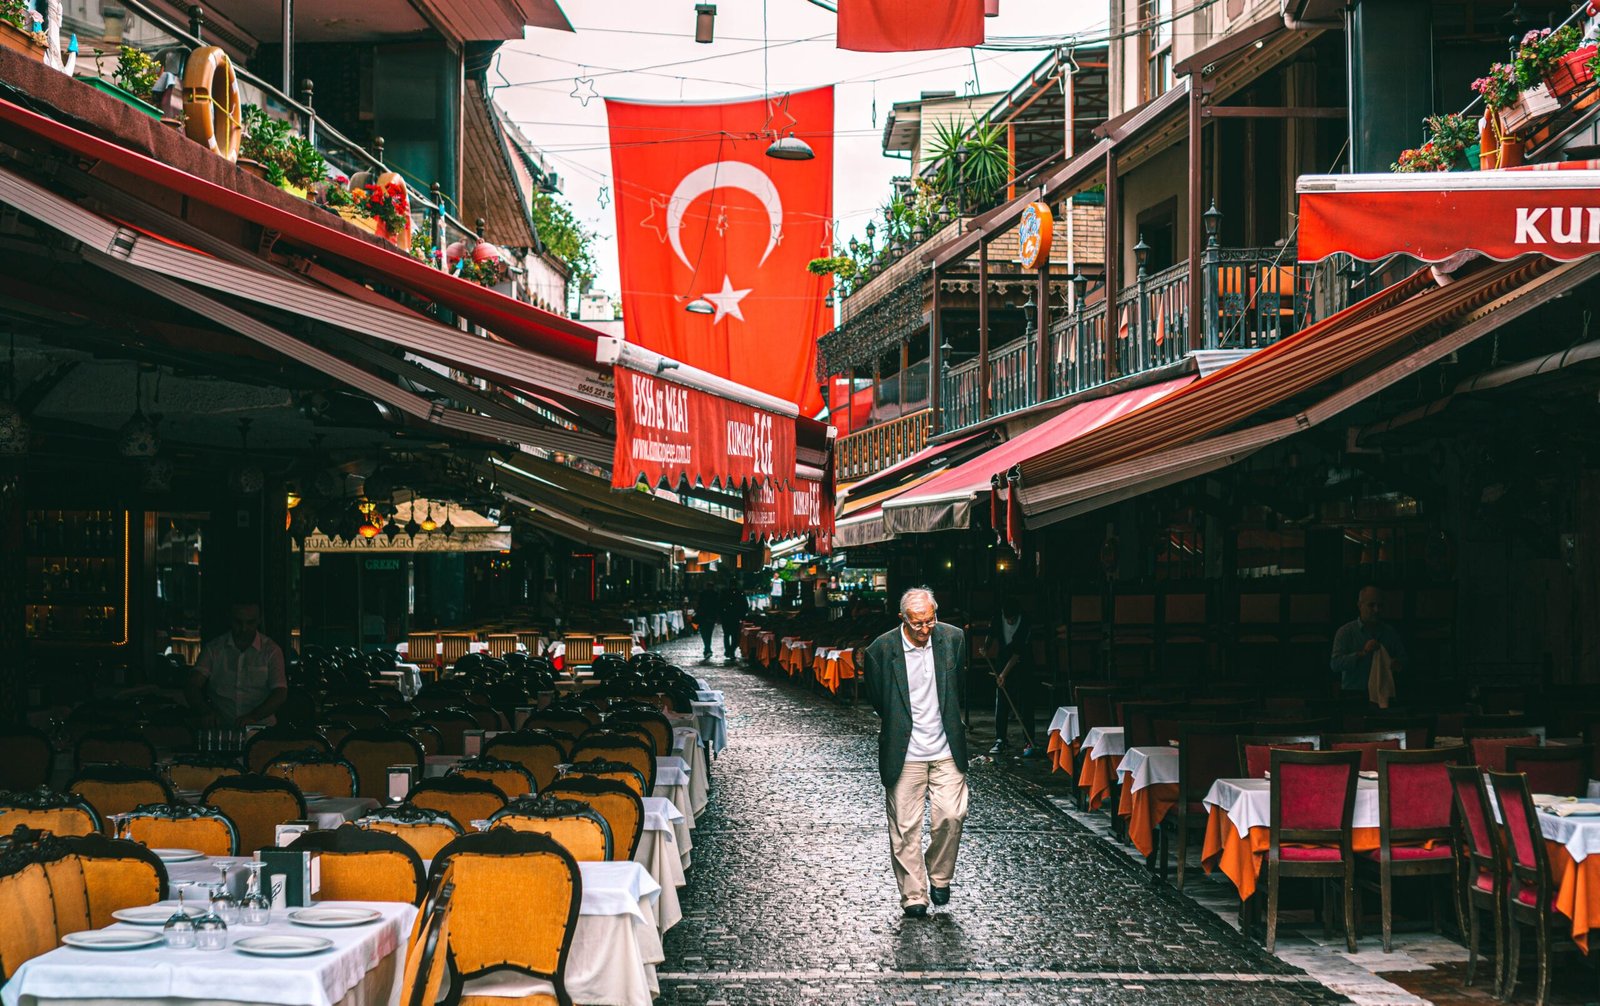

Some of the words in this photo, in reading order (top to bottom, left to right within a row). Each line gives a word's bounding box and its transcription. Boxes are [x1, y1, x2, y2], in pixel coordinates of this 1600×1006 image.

[578, 383, 593, 393] 0545
[594, 388, 606, 396] 221
[632, 374, 656, 428] FISH
[665, 384, 689, 433] MEAT
[754, 411, 774, 474] EGE
[365, 561, 399, 570] GREEN
